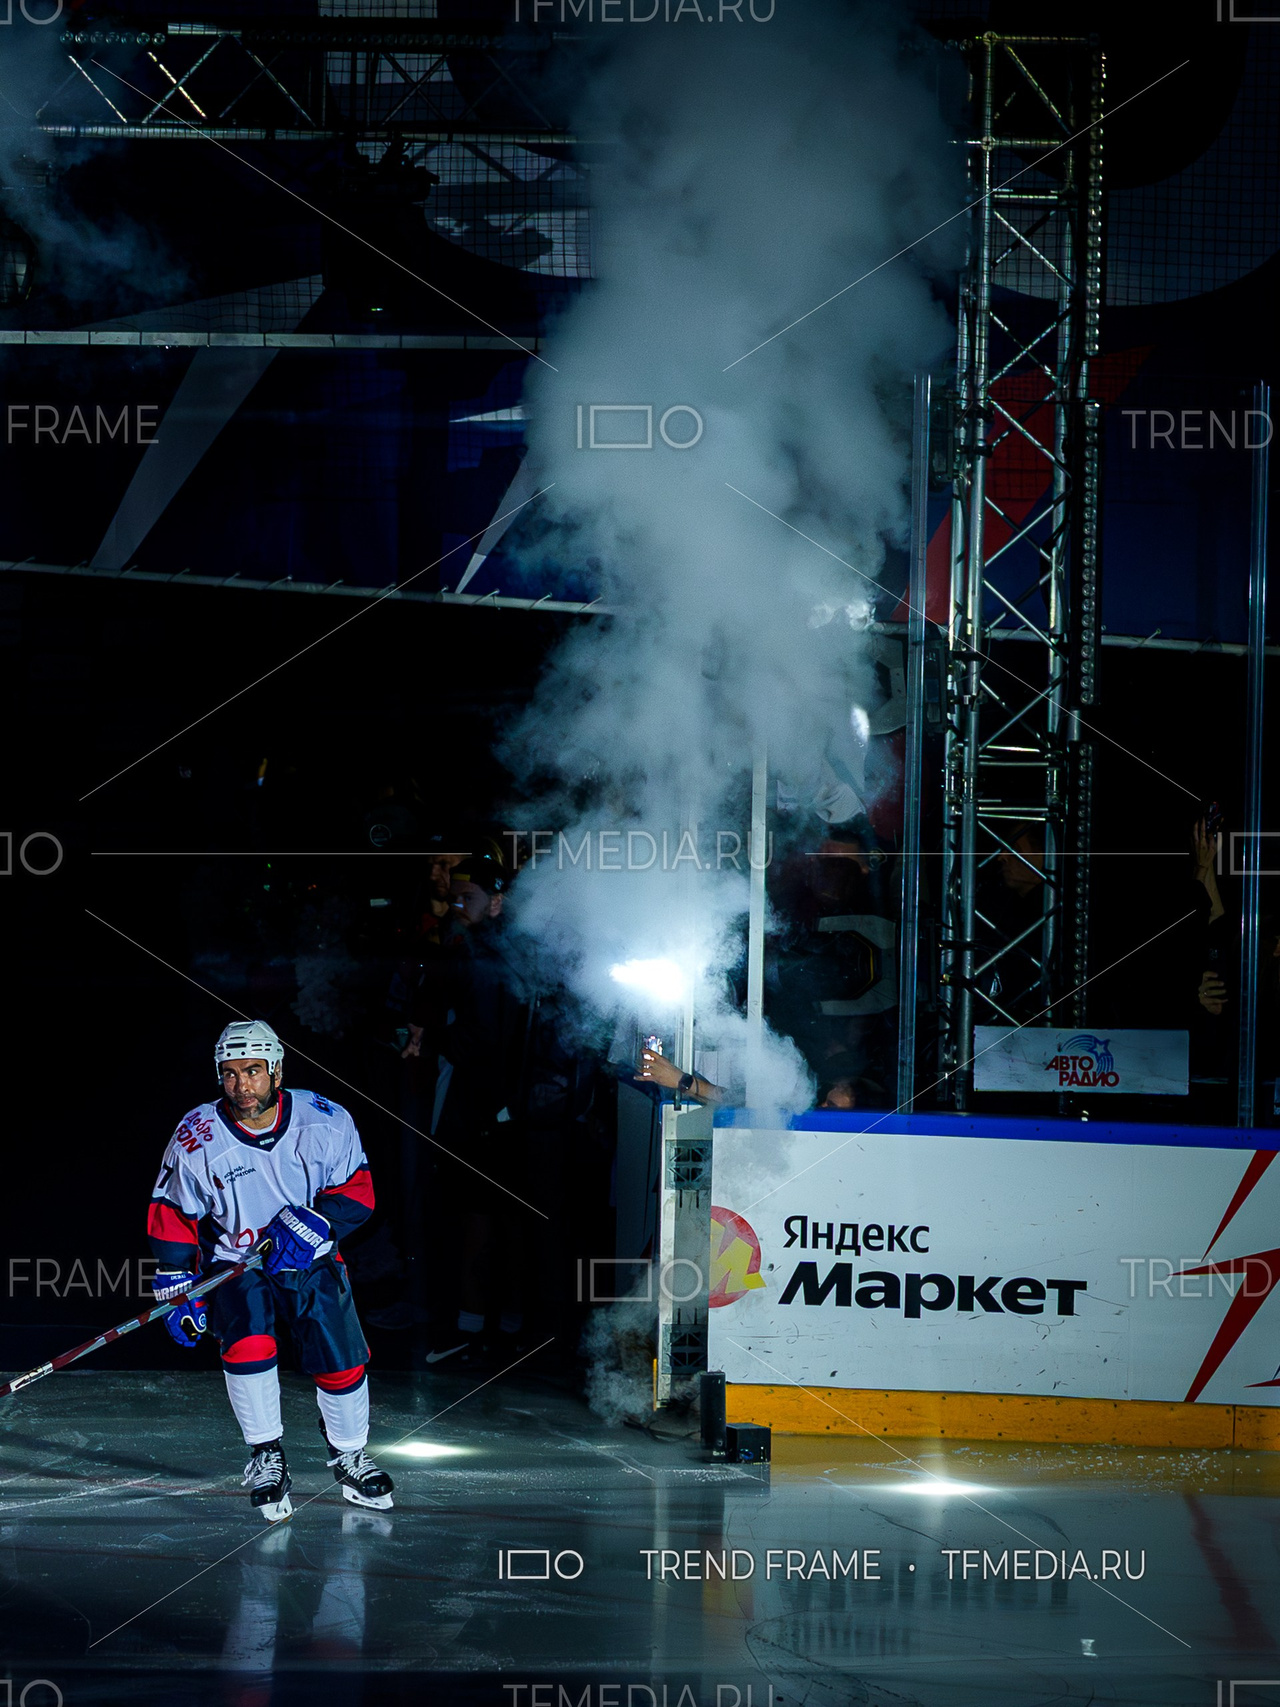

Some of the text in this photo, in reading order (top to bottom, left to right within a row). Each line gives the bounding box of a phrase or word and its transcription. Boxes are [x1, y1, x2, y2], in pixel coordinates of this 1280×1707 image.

[1045, 1055, 1094, 1071] АВТО
[1059, 1071, 1120, 1087] РАДИО
[279, 1207, 324, 1249] WARRIOR
[783, 1215, 930, 1257] Яндекс
[778, 1261, 1088, 1319] Маркет
